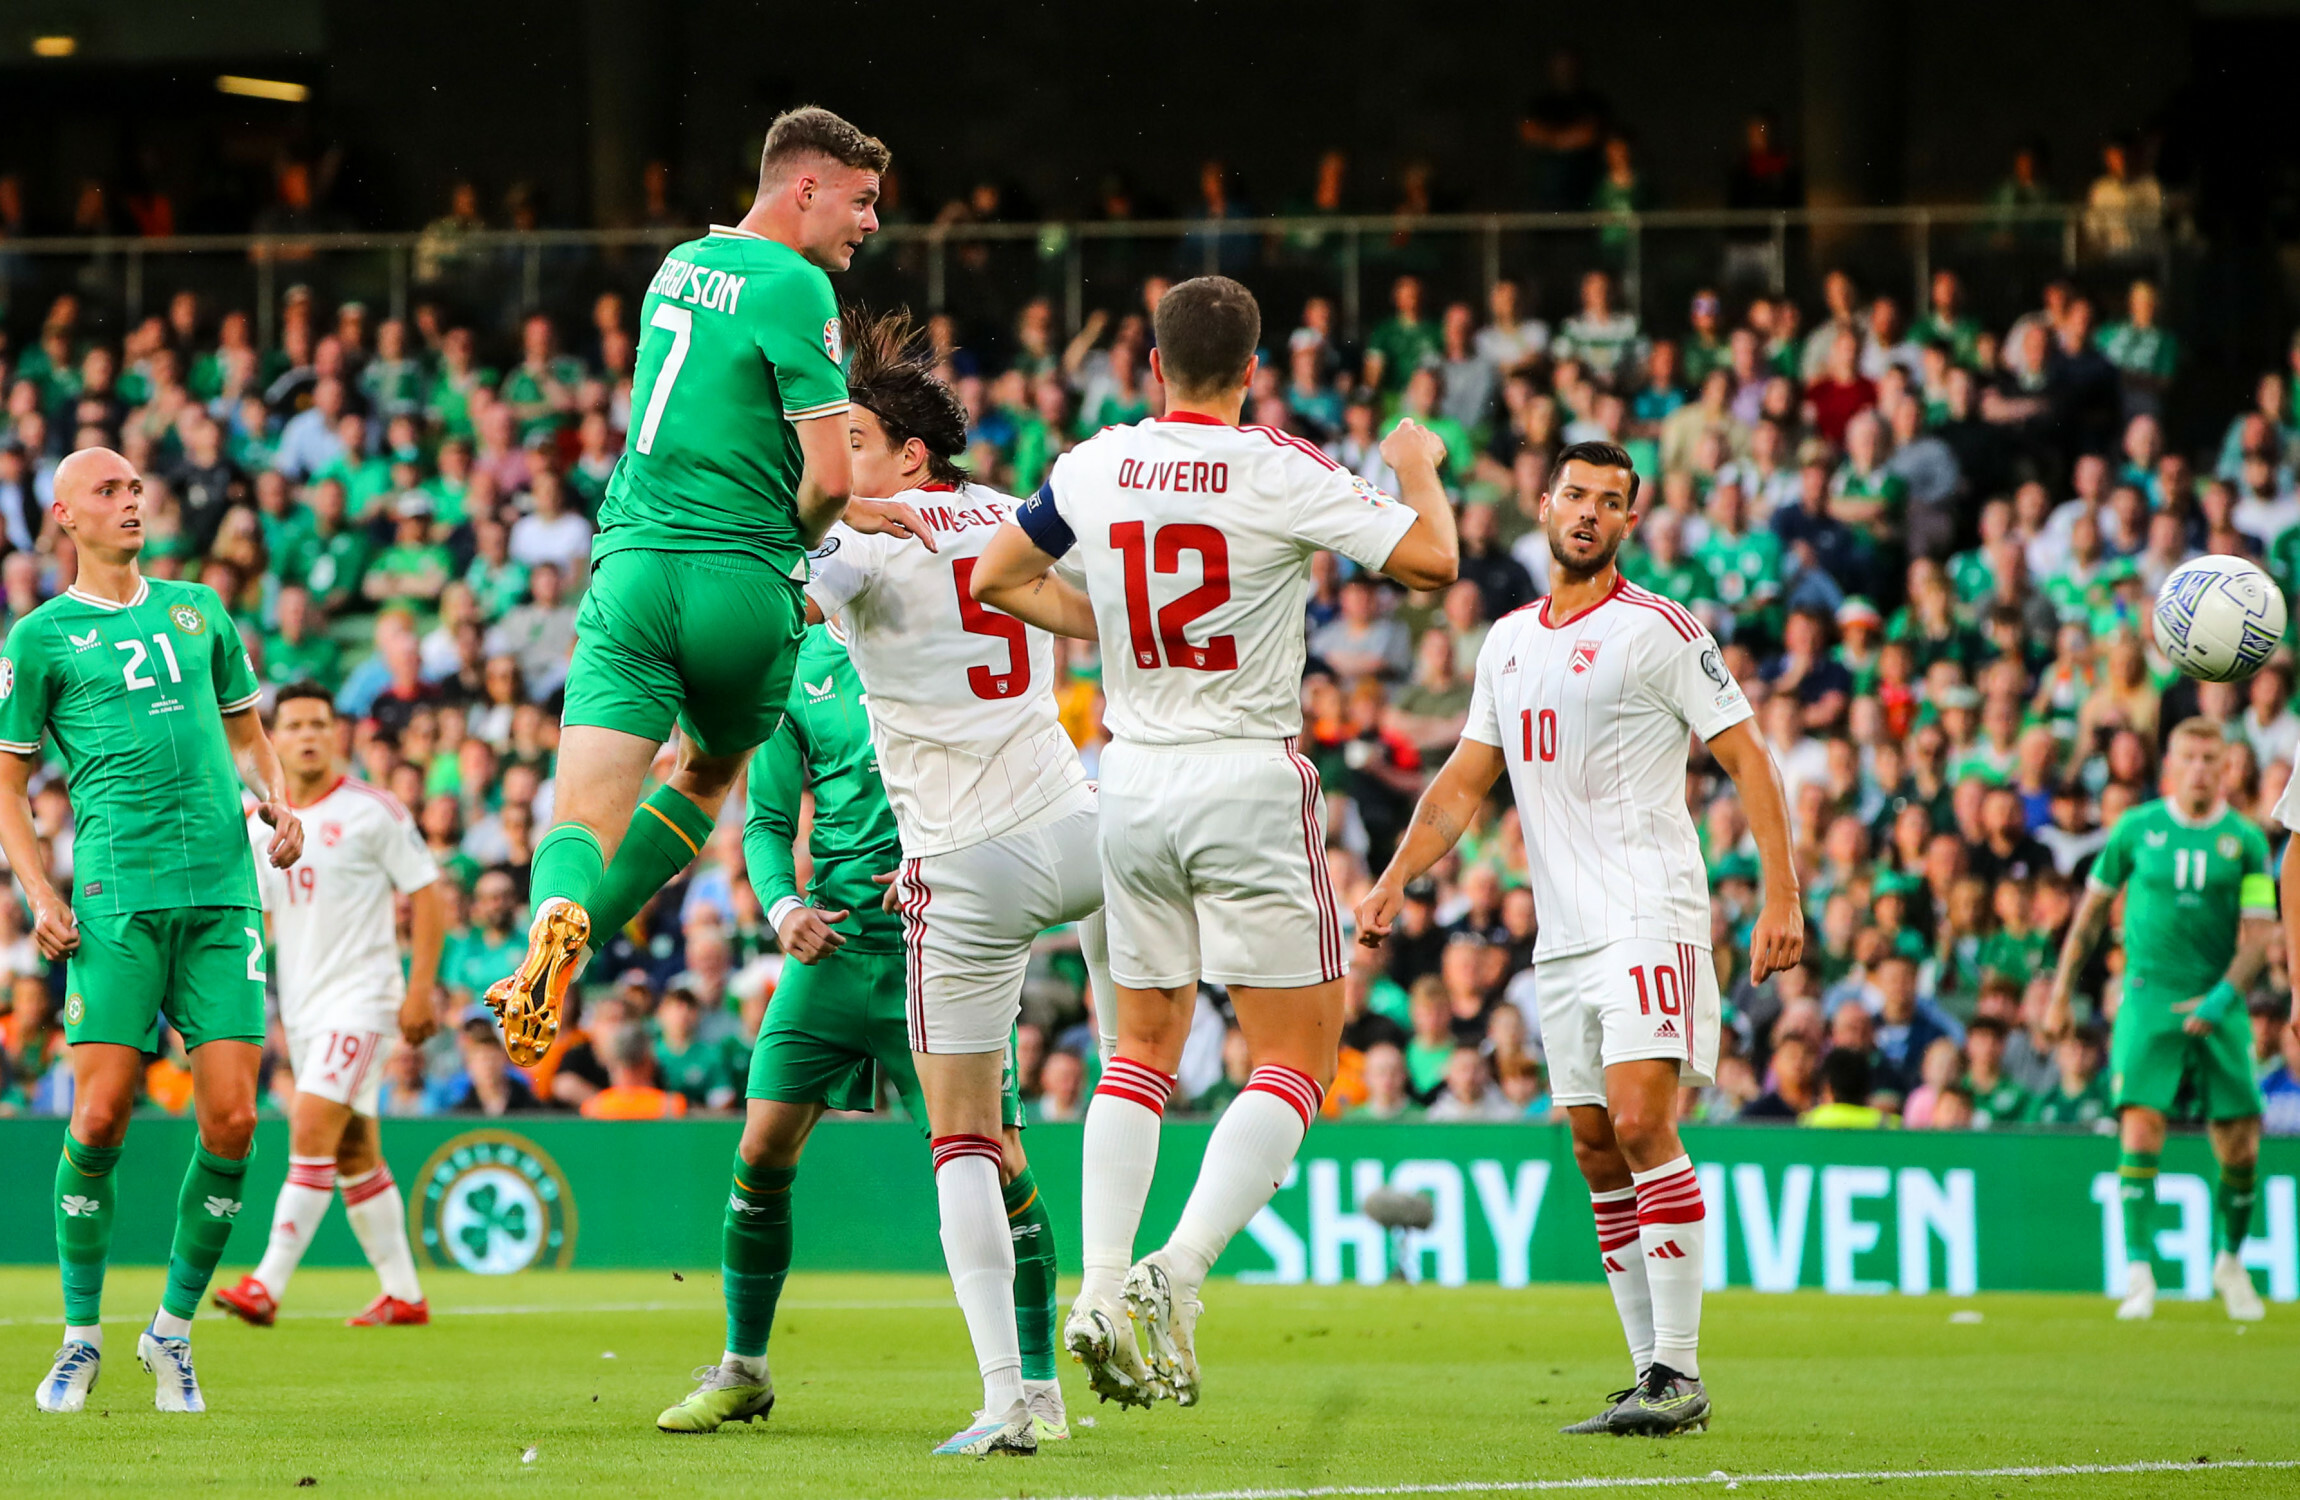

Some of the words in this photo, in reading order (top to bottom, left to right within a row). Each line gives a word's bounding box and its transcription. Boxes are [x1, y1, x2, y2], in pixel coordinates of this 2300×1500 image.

[635, 302, 693, 456] 7
[1118, 458, 1229, 494] OLIVERO
[1109, 520, 1239, 672] 12
[952, 556, 1031, 700] 5
[114, 632, 182, 691] 21
[809, 693, 836, 705] CASTORE
[1521, 708, 1557, 762] 10
[285, 866, 315, 905] 19
[2174, 848, 2207, 891] 11
[1628, 964, 1681, 1016] 10
[324, 1030, 360, 1071] 19
[1653, 1030, 1680, 1039] adidas
